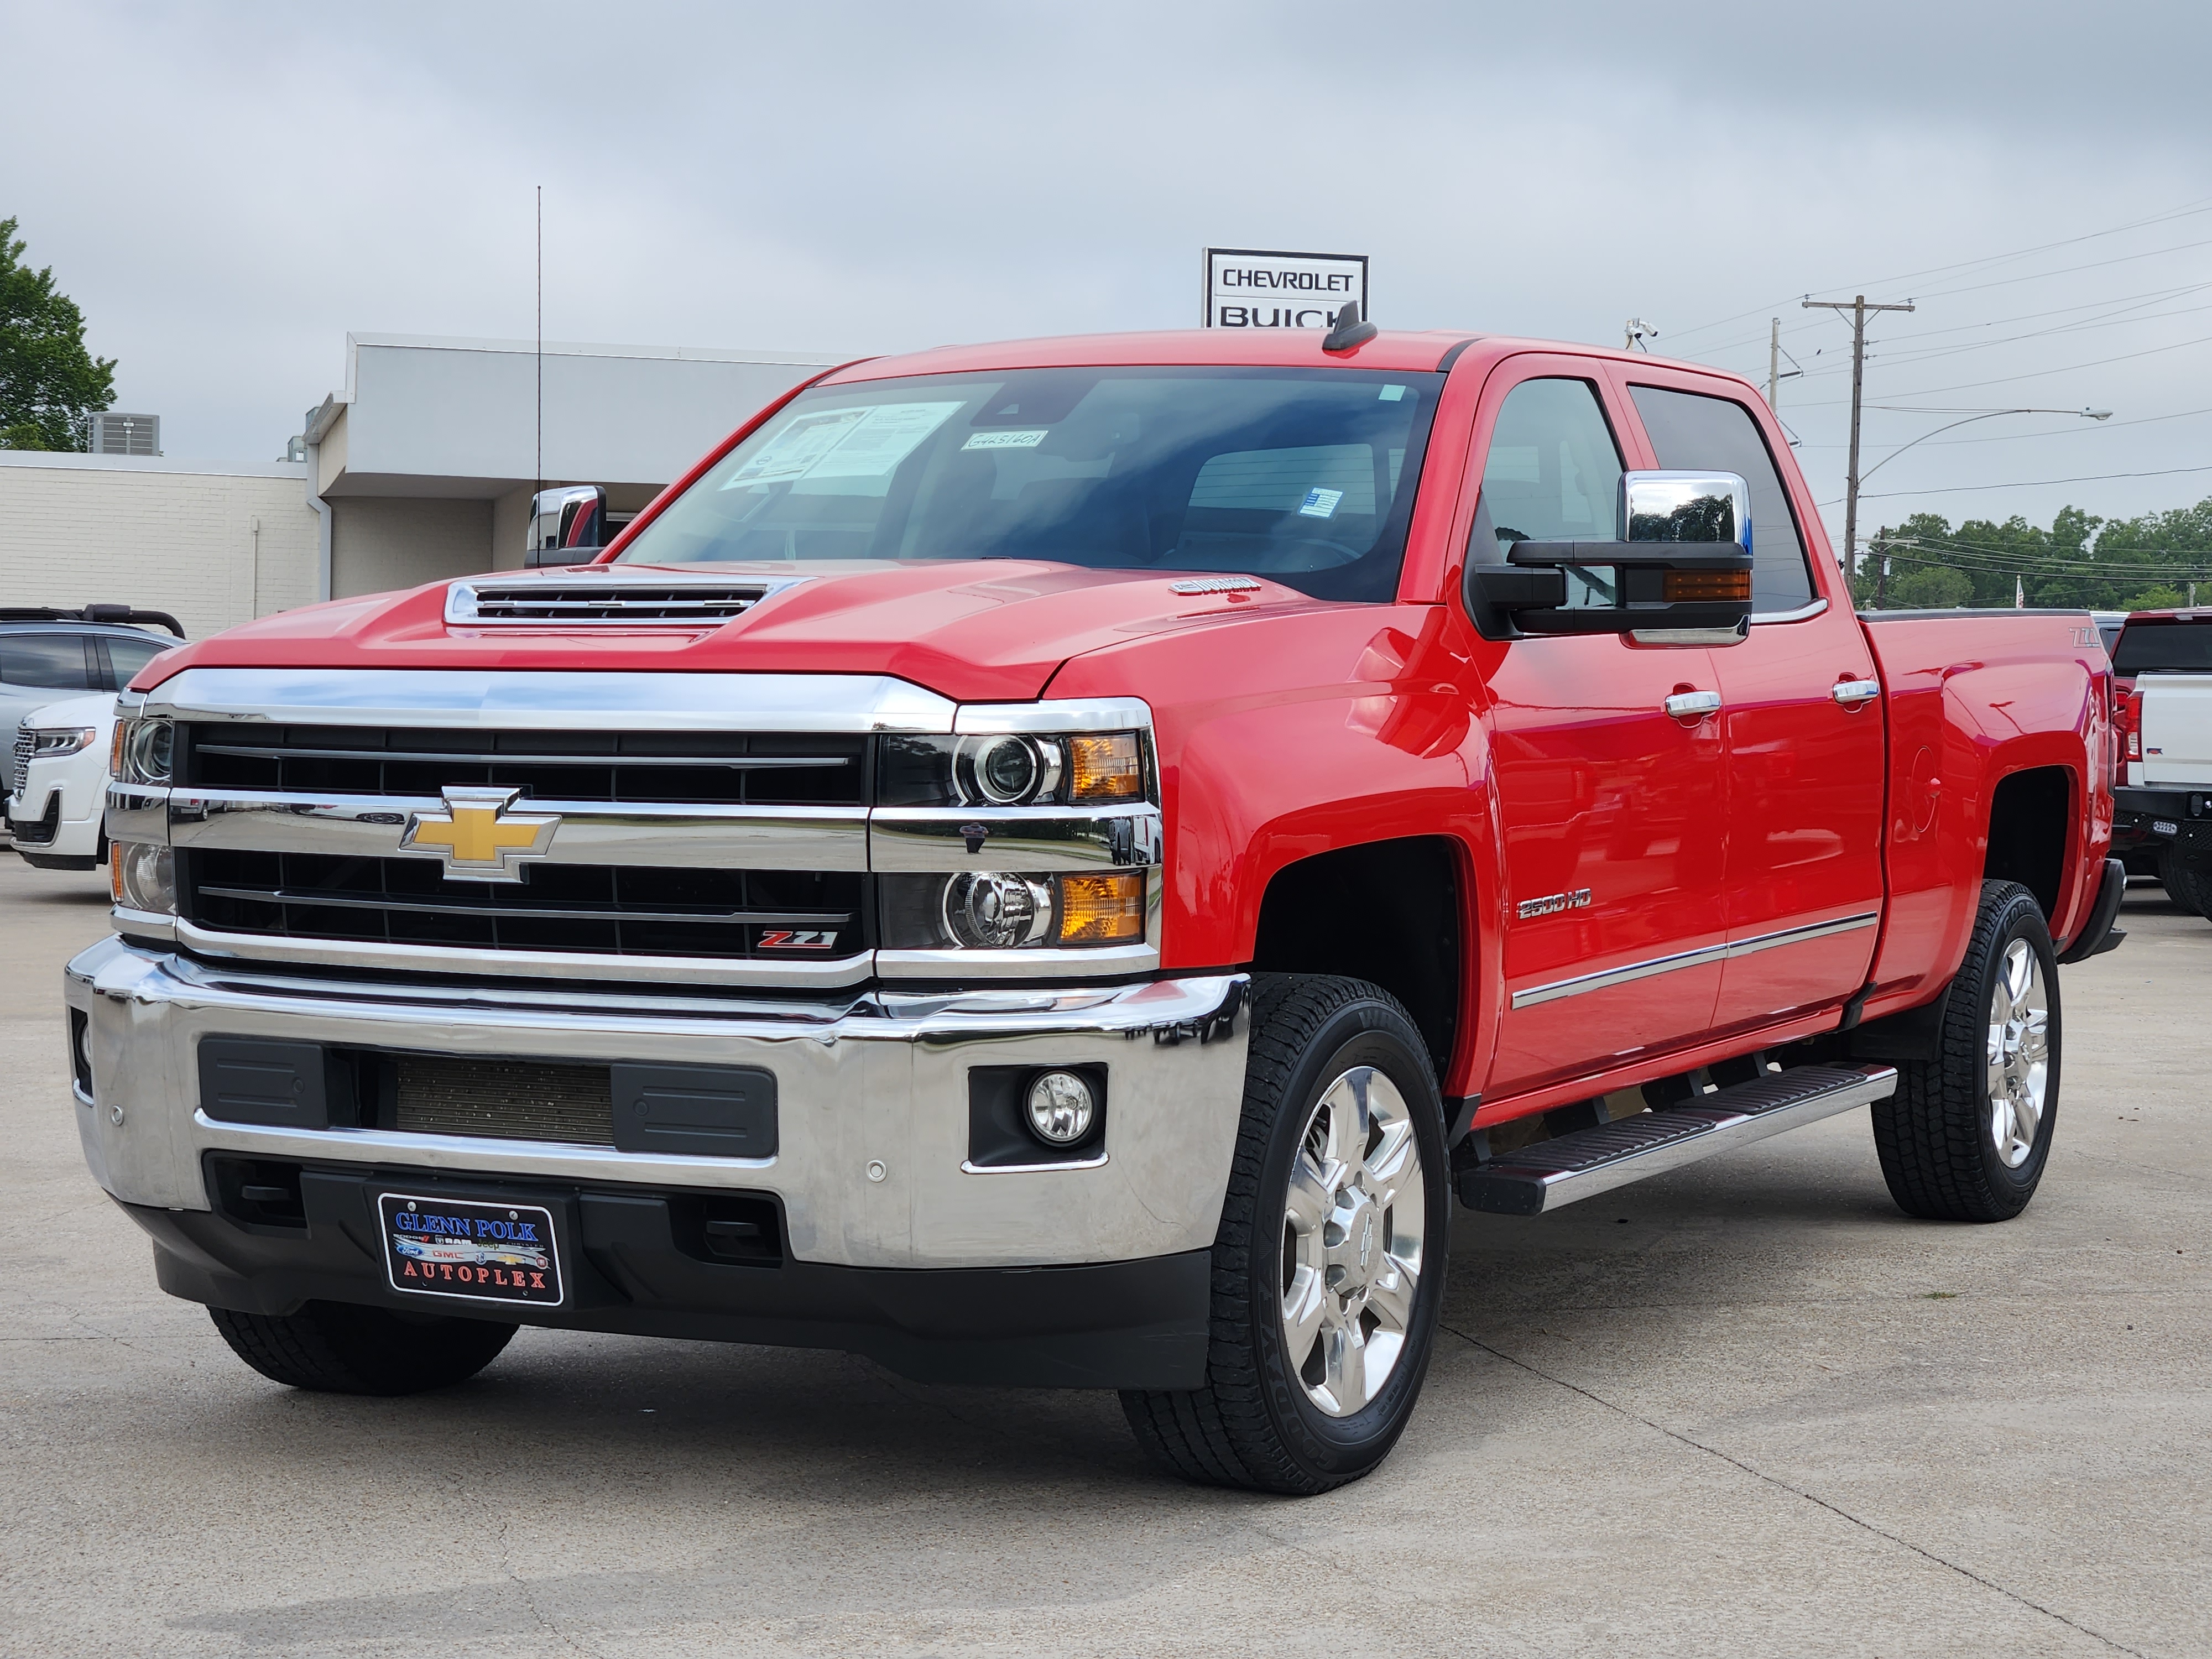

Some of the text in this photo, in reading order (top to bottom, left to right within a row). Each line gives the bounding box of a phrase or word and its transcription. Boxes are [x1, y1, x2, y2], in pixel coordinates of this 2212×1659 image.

[1223, 269, 1354, 291] CHEVROLET
[1520, 888, 1591, 919] 2500 HD
[758, 931, 838, 949] Z71
[396, 1212, 539, 1241] GLENN POLK
[402, 1246, 419, 1255] Ford
[433, 1250, 465, 1259] GMC
[477, 1239, 499, 1250] Jeep
[404, 1261, 545, 1288] AUTOPLEX
